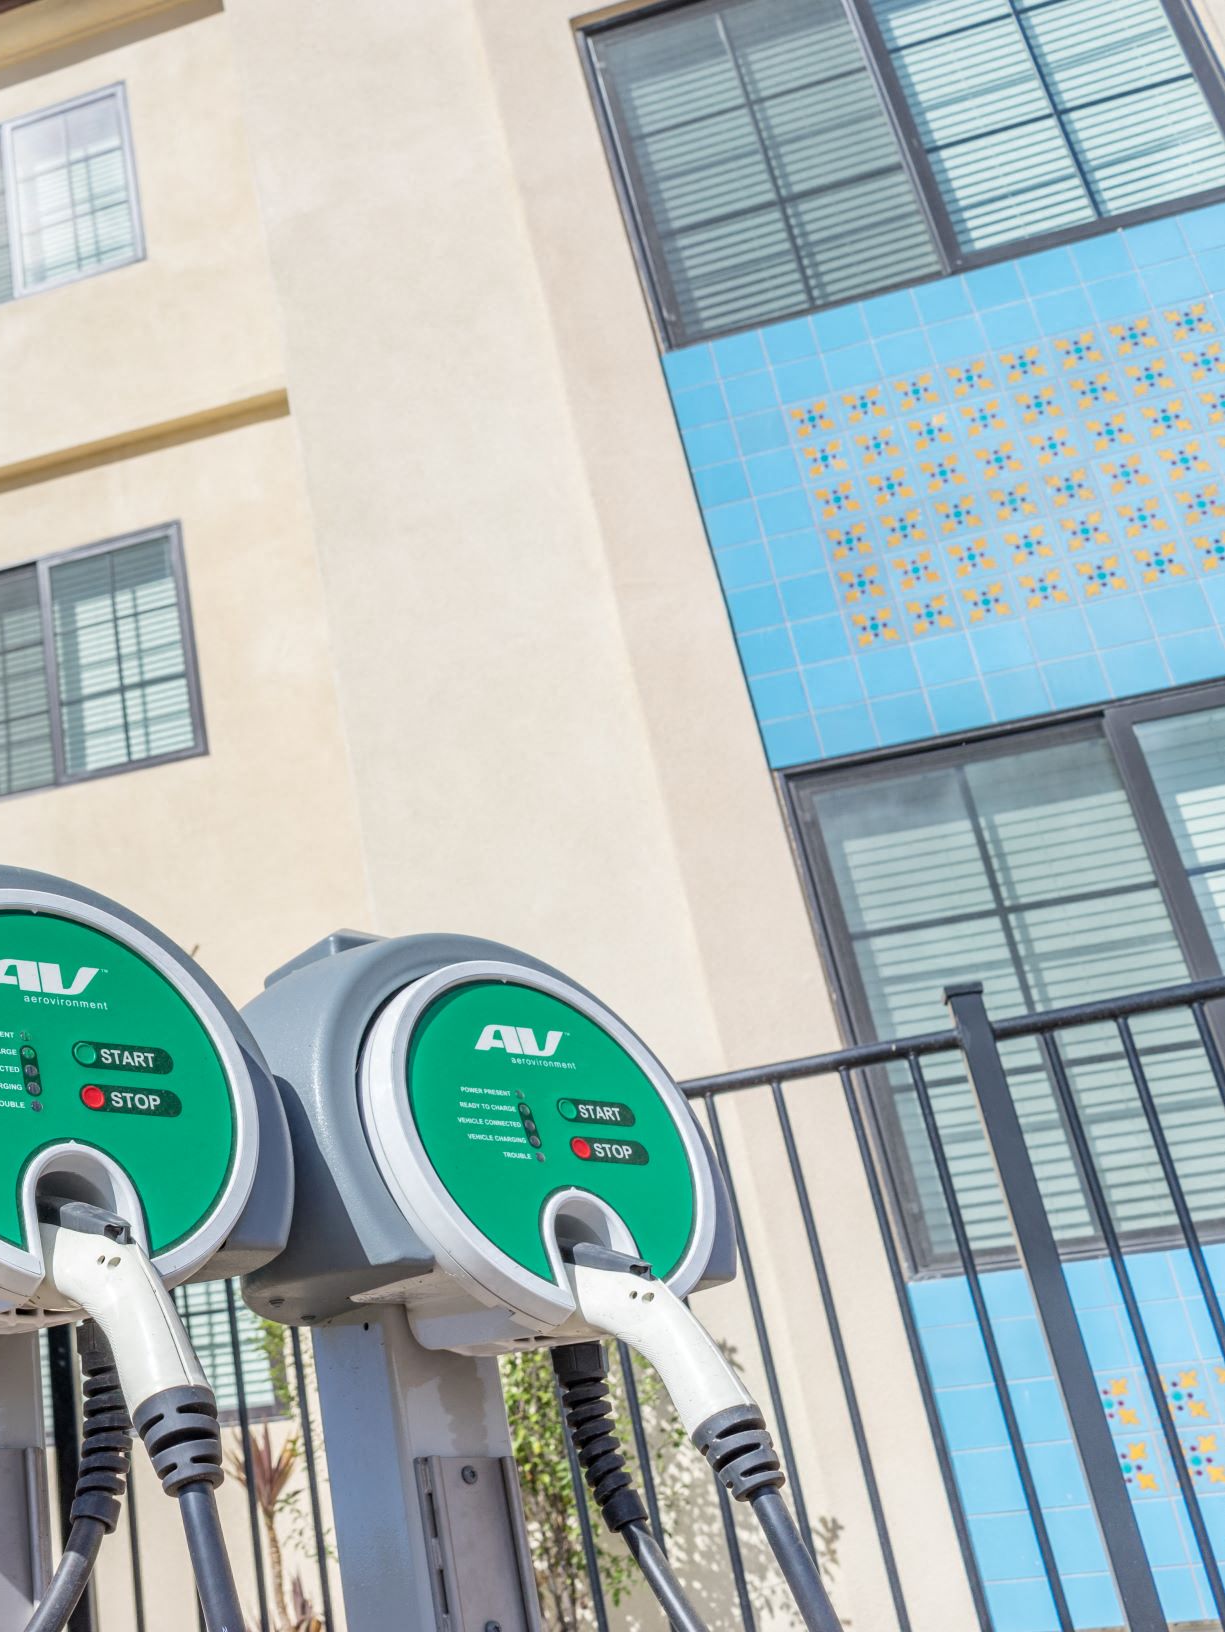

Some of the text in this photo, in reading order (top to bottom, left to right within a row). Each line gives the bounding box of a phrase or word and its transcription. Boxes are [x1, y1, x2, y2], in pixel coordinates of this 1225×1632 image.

[23, 995, 109, 1010] aerovironment
[474, 1024, 563, 1057] AV
[100, 1048, 155, 1068] START
[510, 1057, 576, 1070] aerovironment
[460, 1086, 511, 1096] POWER PRESENT
[110, 1091, 161, 1110] STOP
[491, 1104, 517, 1112] CHARGE
[578, 1104, 621, 1121] START
[457, 1117, 522, 1128] VEHICLE CONNECTED
[467, 1133, 527, 1144] VEHICLE CHARGING
[503, 1151, 533, 1160] TROUBLE
[593, 1142, 633, 1159] STOP
